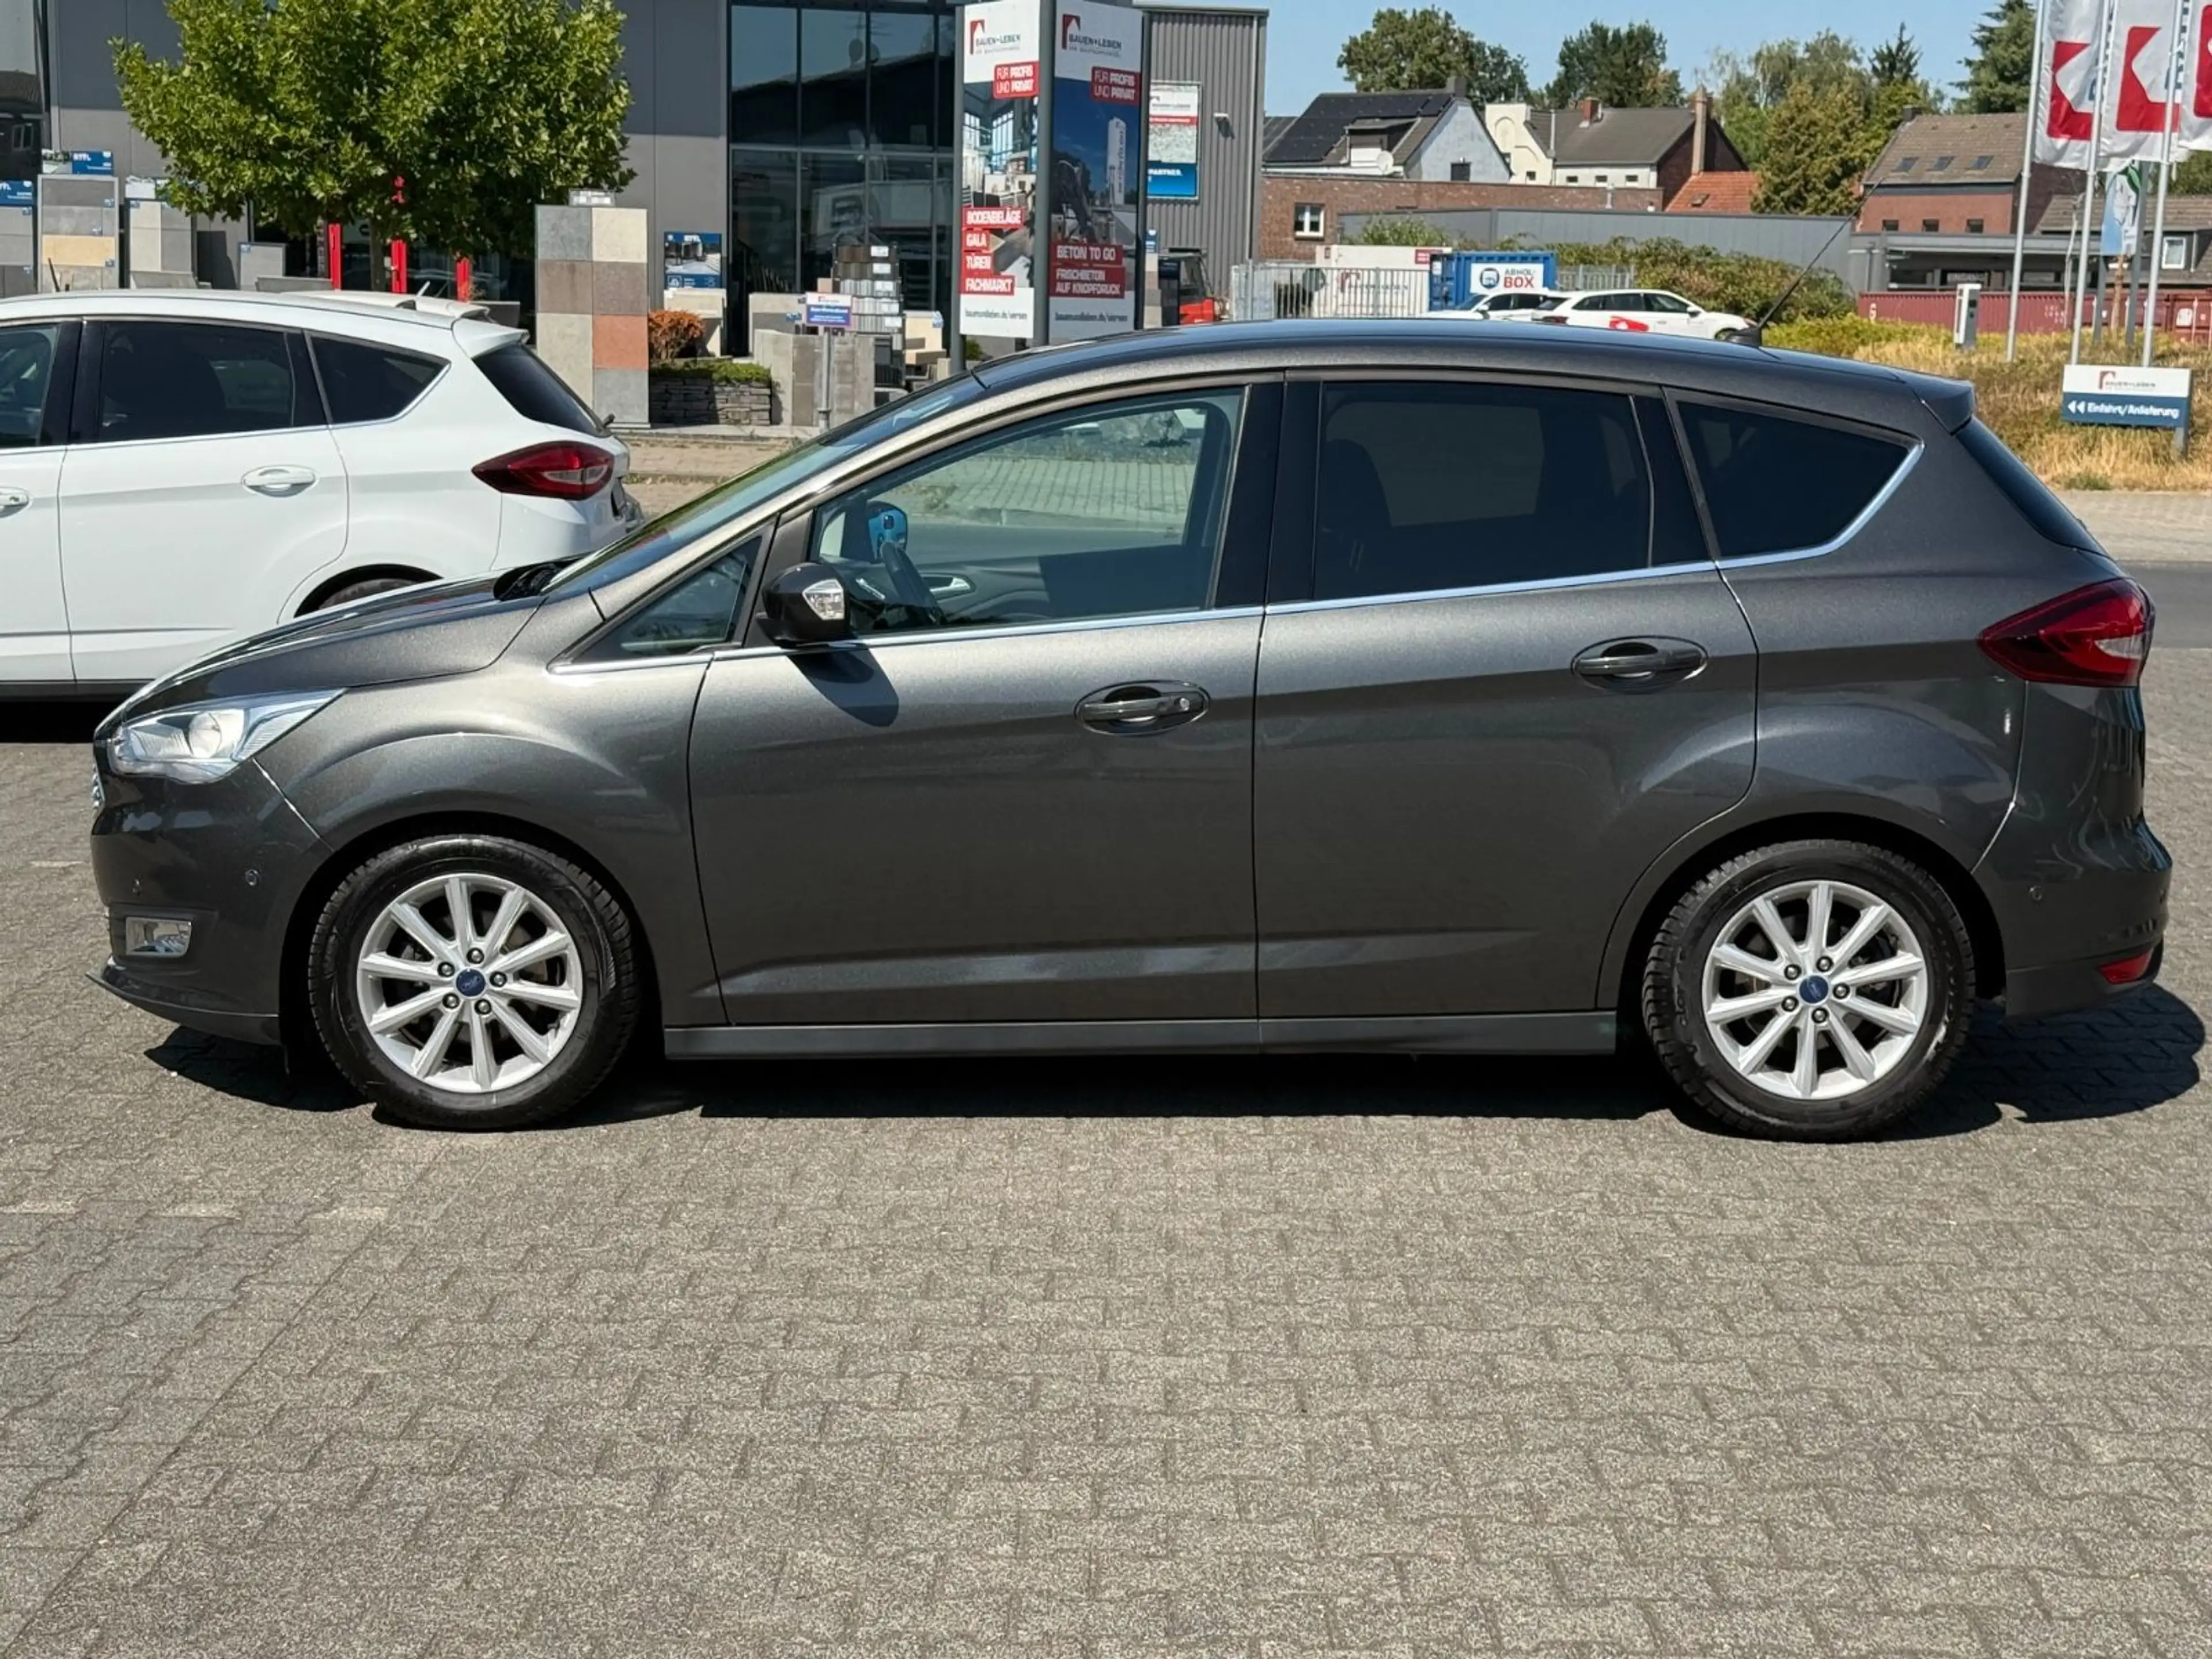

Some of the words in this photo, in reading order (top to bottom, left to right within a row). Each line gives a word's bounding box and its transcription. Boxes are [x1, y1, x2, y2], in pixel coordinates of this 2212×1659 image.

[966, 232, 987, 247] GALA
[1057, 245, 1087, 259] BETON
[1089, 246, 1101, 260] TO
[1103, 247, 1116, 261] GO
[965, 278, 1013, 293] FACHMARKT
[1055, 281, 1071, 294] AUF
[1072, 282, 1121, 295] KNOPFDRUCK
[1504, 276, 1535, 289] BOX
